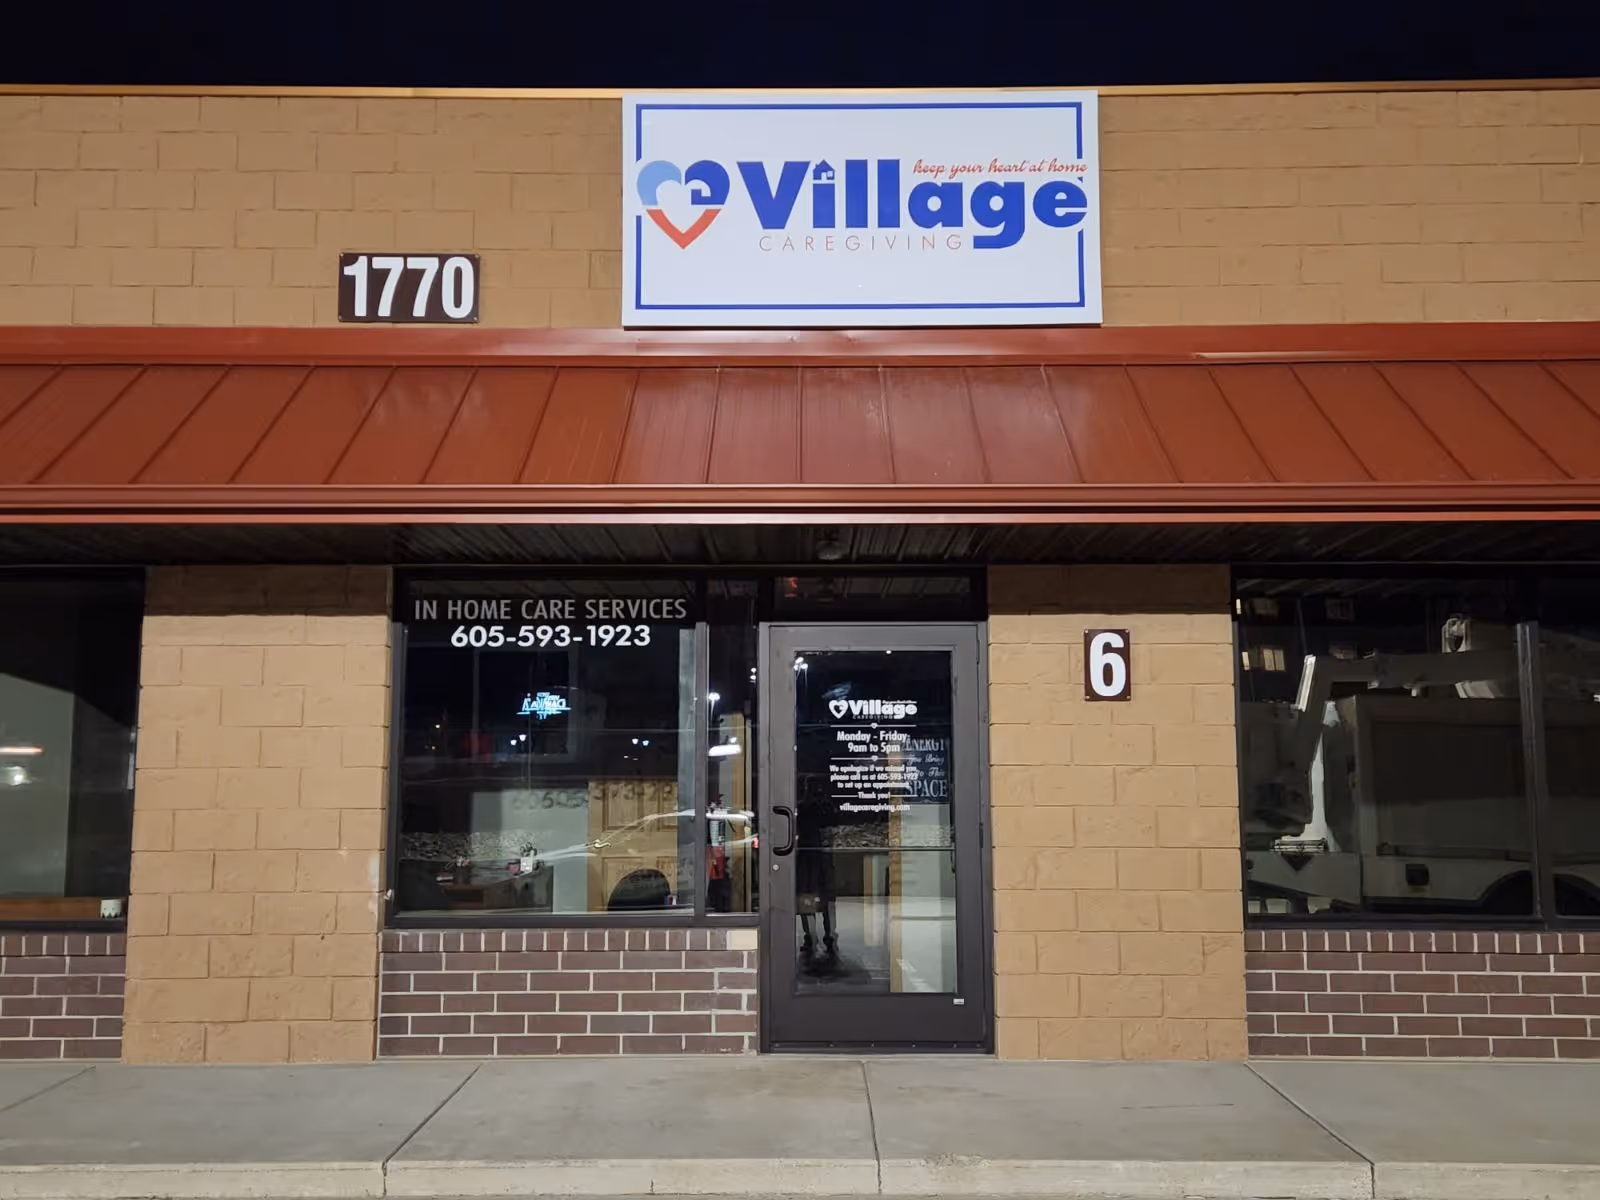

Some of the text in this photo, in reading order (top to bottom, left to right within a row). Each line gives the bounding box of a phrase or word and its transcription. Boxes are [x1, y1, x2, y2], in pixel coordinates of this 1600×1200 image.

[913, 157, 1088, 180] keep your heart at home
[736, 158, 1088, 249] Village
[759, 234, 962, 252] CAREGIVING
[343, 255, 475, 319] 1770
[415, 598, 687, 620] IN HOME CARE SERVICES
[450, 624, 651, 648] 605-593-1923
[1089, 632, 1126, 697] 6
[848, 699, 918, 719] Village
[836, 730, 871, 743] Monday
[847, 742, 901, 754] 9am to 5pm
[907, 780, 948, 797] SPACE
[839, 802, 911, 813] villagecaregiving.com
